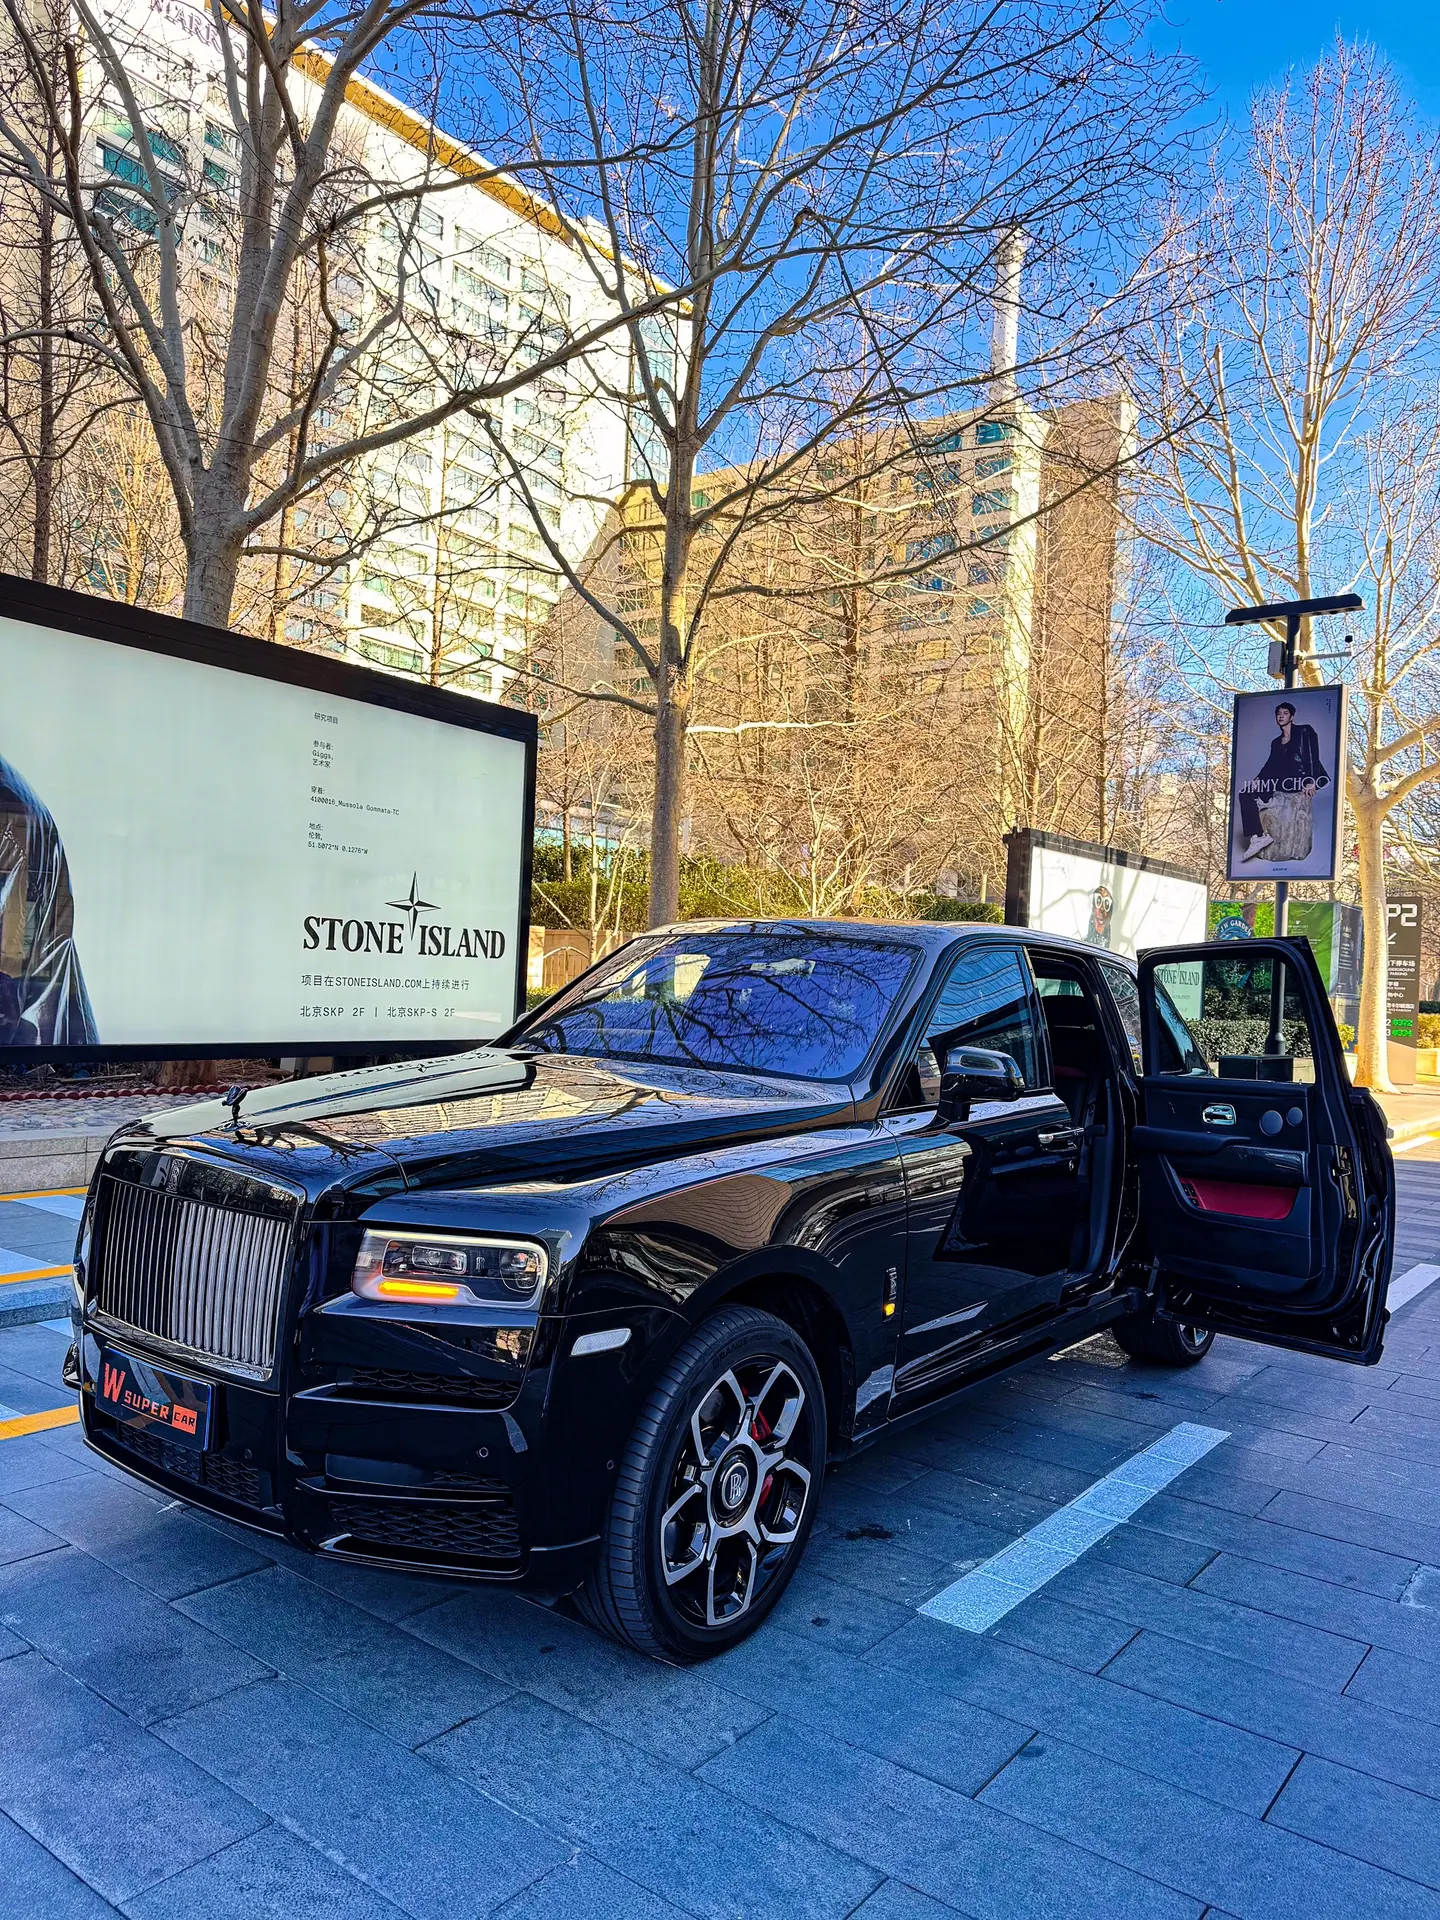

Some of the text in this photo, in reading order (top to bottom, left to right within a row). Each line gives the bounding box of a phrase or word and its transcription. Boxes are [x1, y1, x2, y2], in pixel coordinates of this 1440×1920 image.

[313, 711, 338, 725] 研究项目
[312, 749, 334, 761] Giggs,
[312, 758, 331, 769] 艺术家
[1239, 775, 1331, 794] JIMMY CHOO
[303, 915, 507, 959] STONE ISLAND
[301, 974, 470, 991] 项目在STONEISLAND.COM上持续进行
[1179, 970, 1200, 986] ISLAND
[300, 1006, 344, 1018] 北京SKP
[352, 1006, 365, 1017] 2F
[386, 1006, 438, 1018] 北京SKP-S
[444, 1007, 456, 1018] 2F
[103, 1362, 196, 1428] W SUPER CAR
